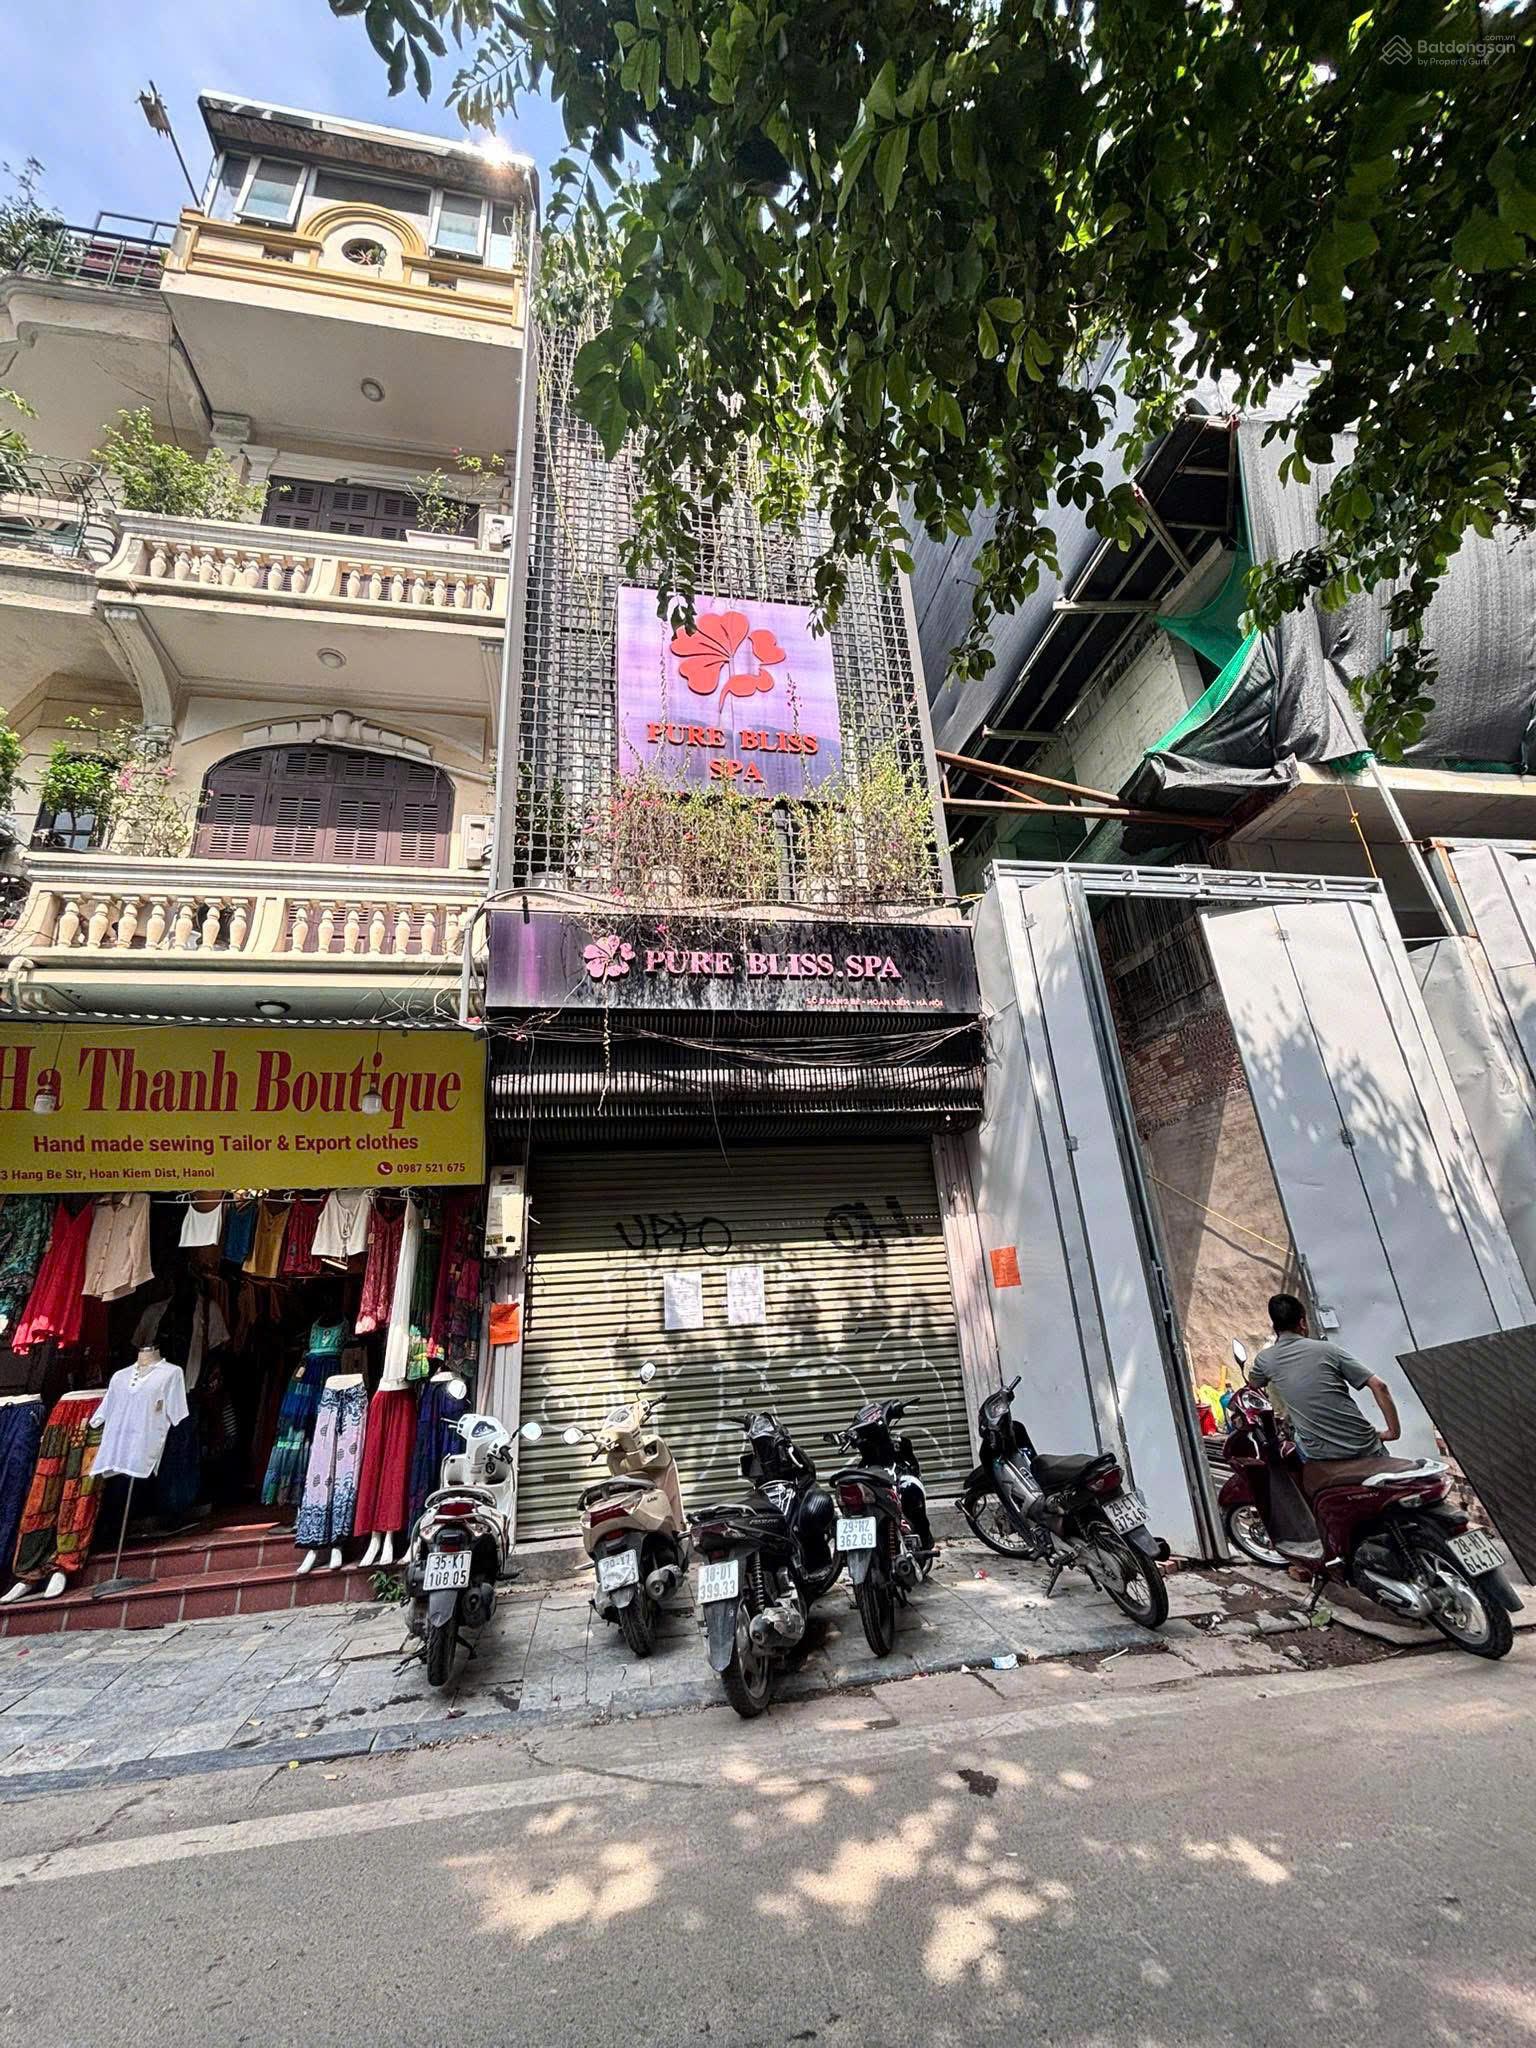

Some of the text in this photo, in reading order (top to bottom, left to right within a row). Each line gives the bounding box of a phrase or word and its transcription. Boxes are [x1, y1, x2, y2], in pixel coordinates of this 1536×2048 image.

[646, 722, 819, 754] PURE BLISS
[709, 759, 763, 782] SPA
[645, 949, 735, 977] PURE
[0, 1046, 462, 1129] Ha Thanh Boutique
[34, 1133, 419, 1156] Hand made sewing Tailor & Export clothes
[12, 1170, 43, 1181] Hang
[46, 1170, 62, 1180] Be
[65, 1169, 86, 1181] Str,
[89, 1168, 119, 1179] Hoan
[122, 1168, 151, 1178] Kiem
[154, 1168, 180, 1179] Dist,
[182, 1167, 215, 1178] Hanoi
[397, 1162, 466, 1173] 0987 521 675
[700, 1580, 736, 1600] 399.33
